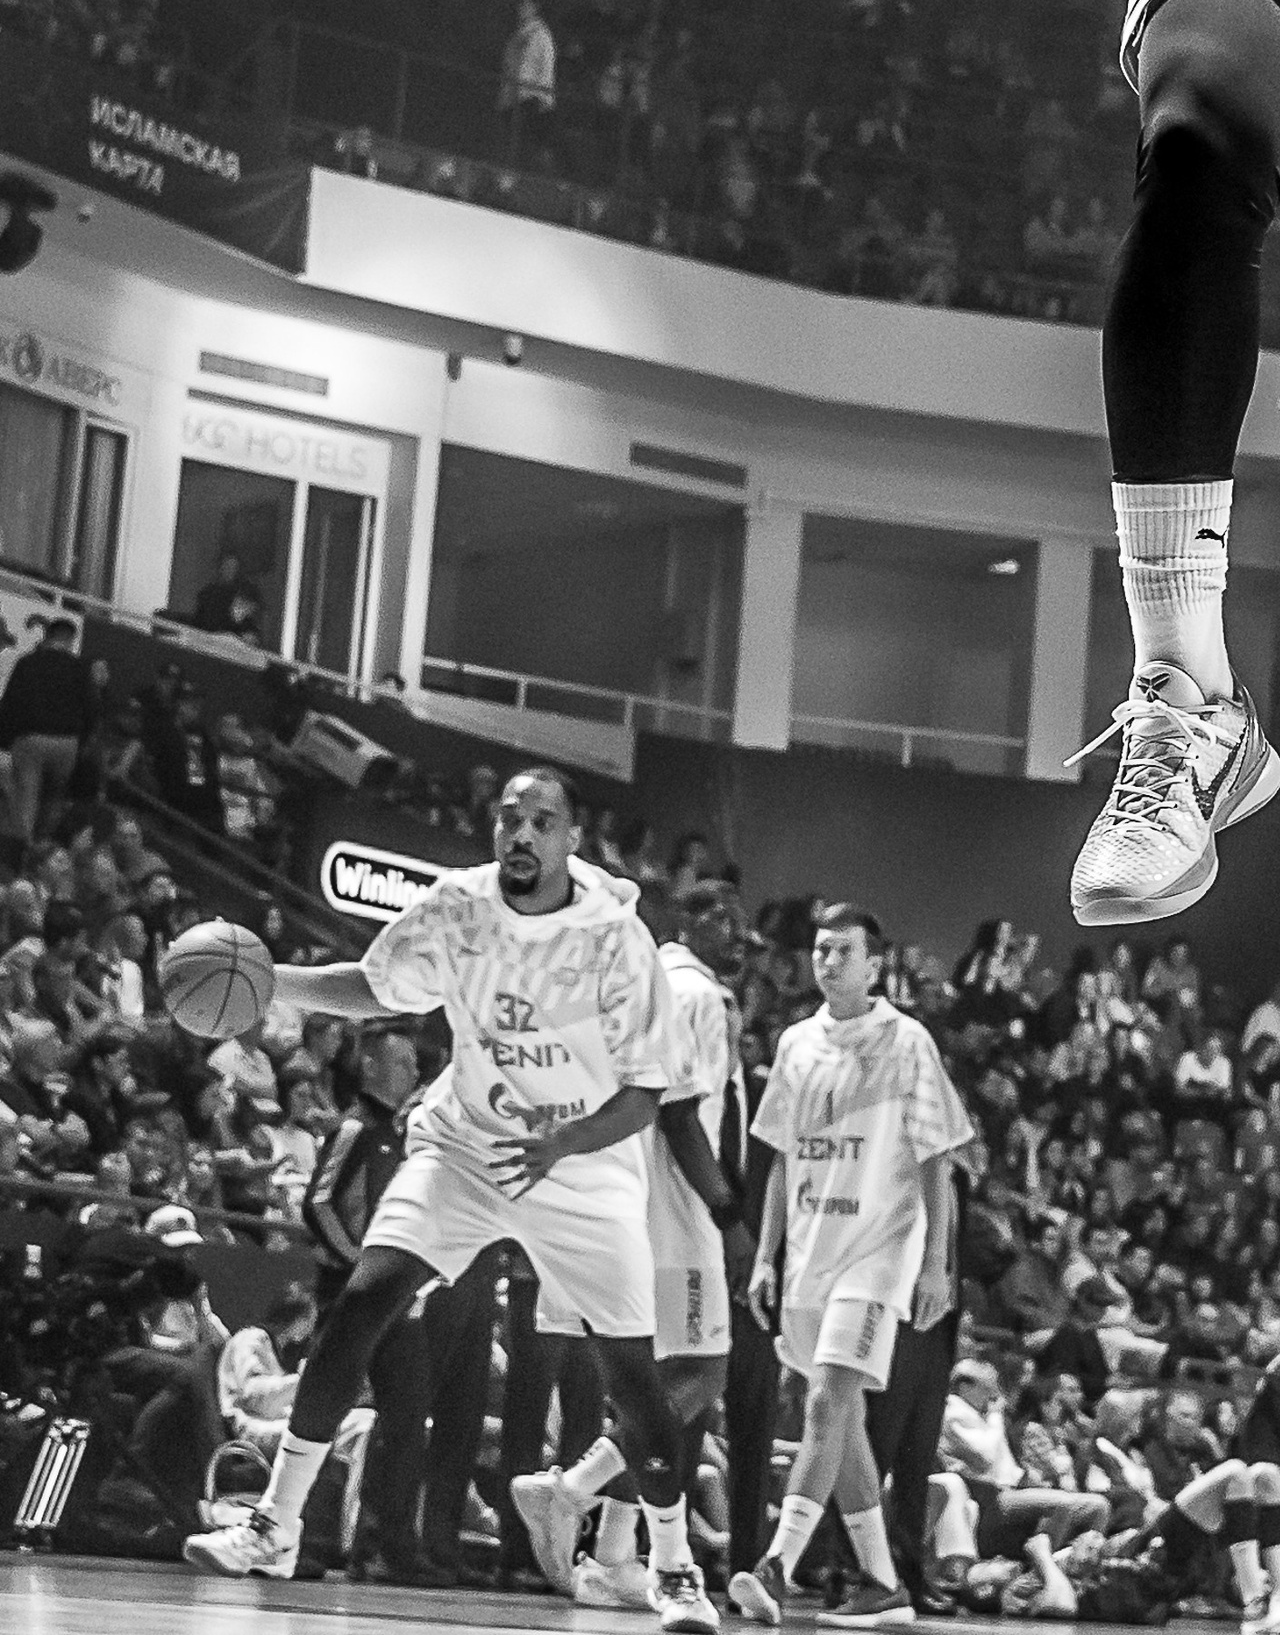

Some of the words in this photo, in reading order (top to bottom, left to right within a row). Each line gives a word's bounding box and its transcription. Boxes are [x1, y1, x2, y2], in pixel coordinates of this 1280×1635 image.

[88, 96, 241, 183] ИСЛАМСКАЯ
[87, 140, 165, 195] КАРТА
[494, 991, 539, 1033] 32
